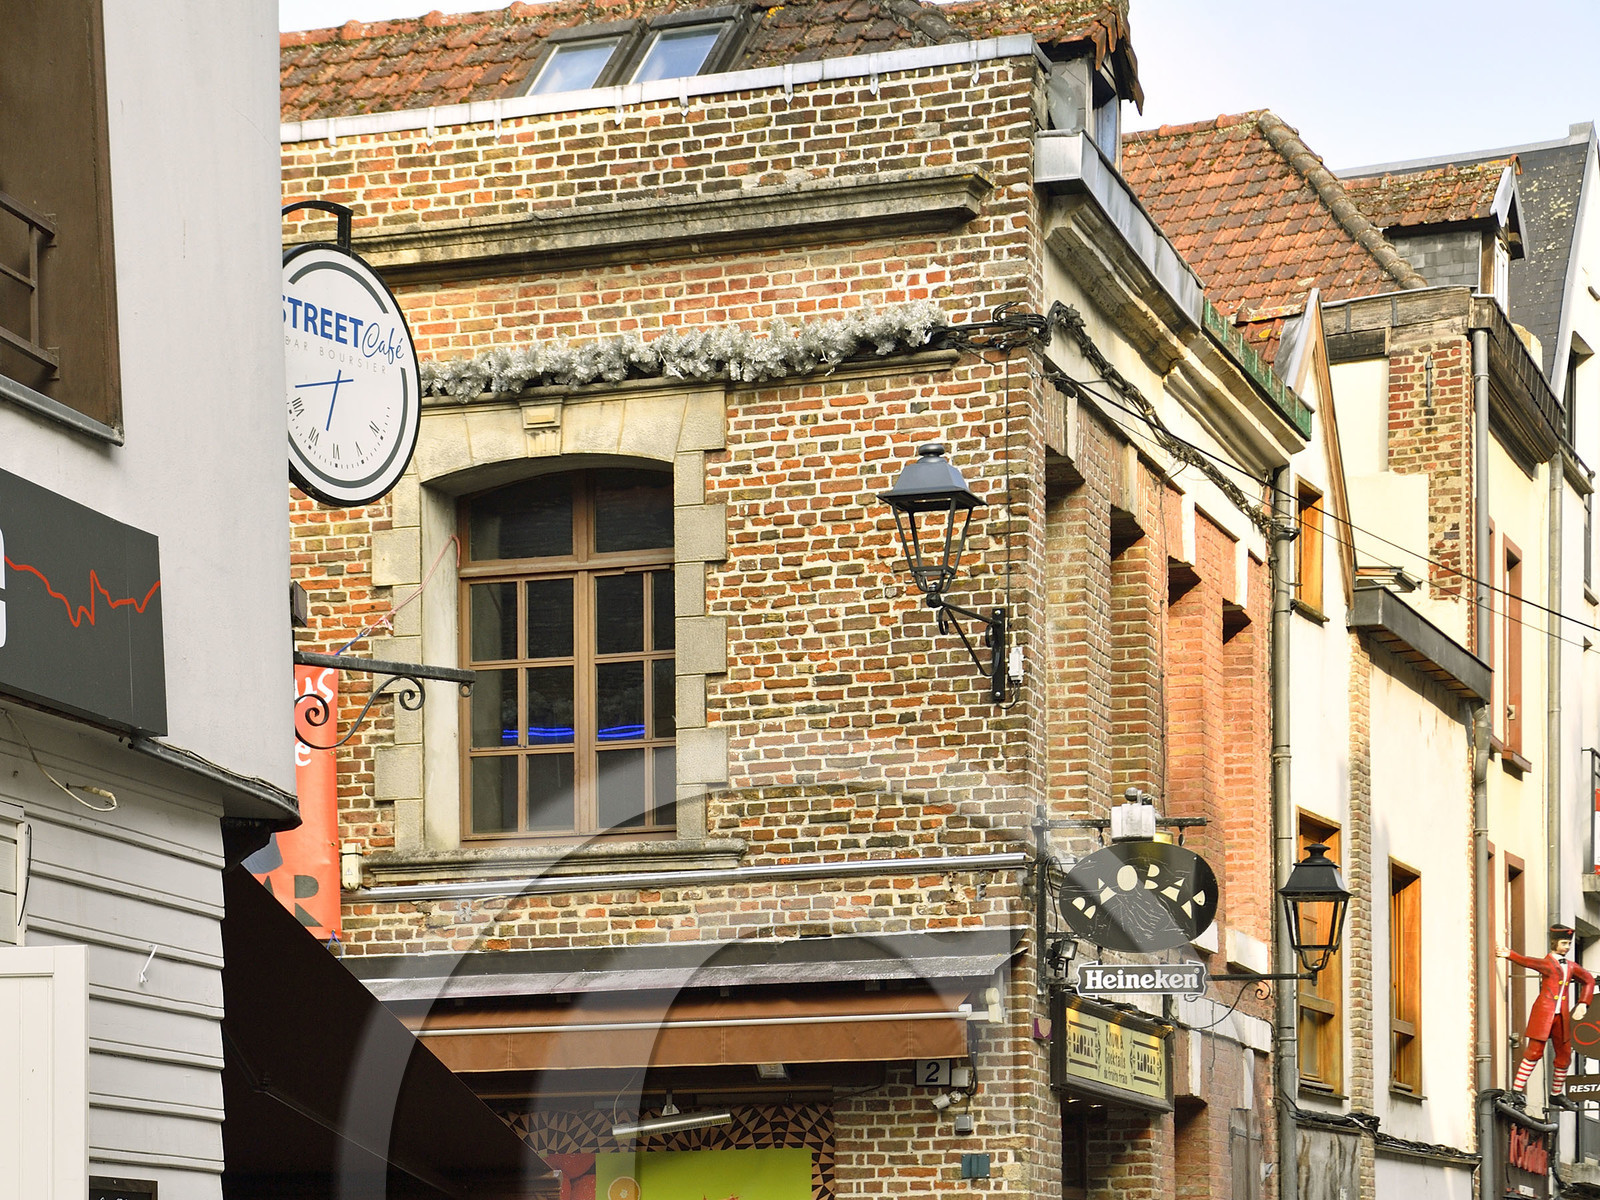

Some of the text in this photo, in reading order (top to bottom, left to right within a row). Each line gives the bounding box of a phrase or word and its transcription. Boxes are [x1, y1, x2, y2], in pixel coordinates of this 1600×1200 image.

[362, 322, 405, 365] Café
[319, 346, 386, 374] BOURSIER
[1085, 968, 1199, 990] Heineken
[925, 1062, 941, 1083] 2
